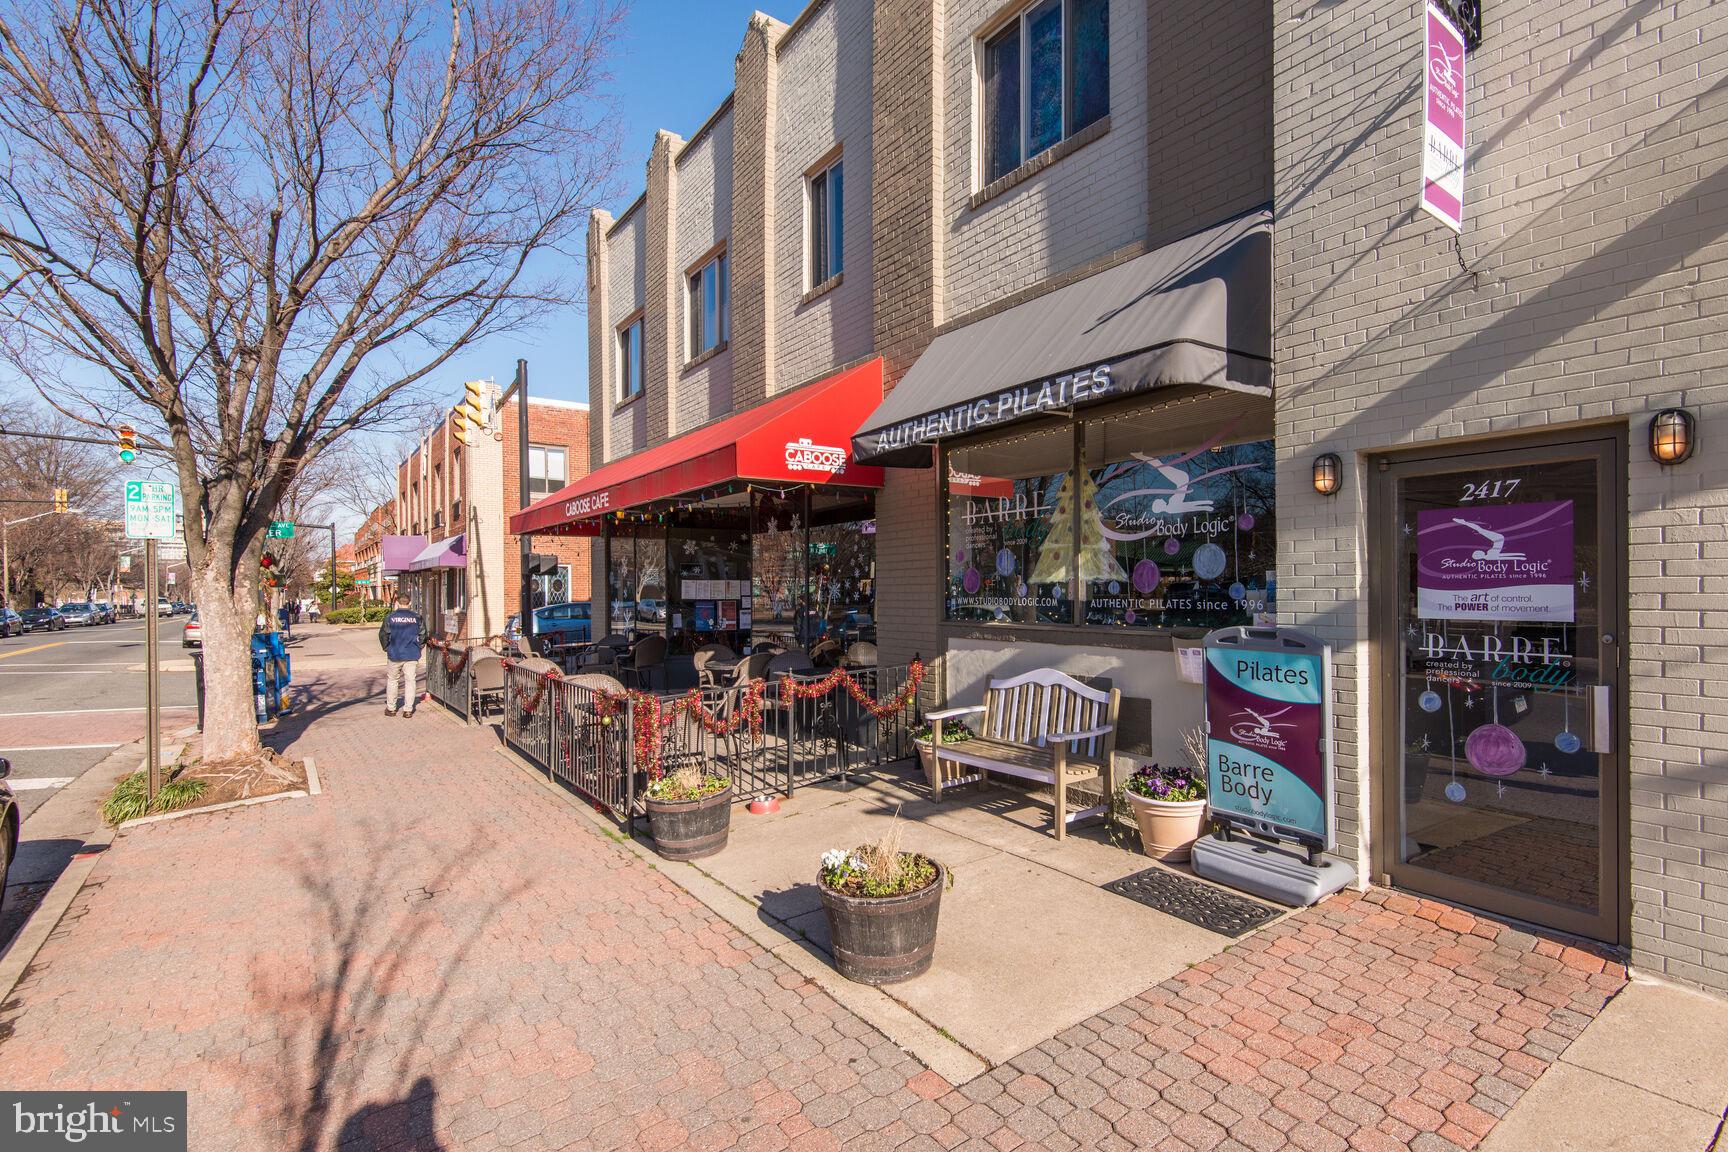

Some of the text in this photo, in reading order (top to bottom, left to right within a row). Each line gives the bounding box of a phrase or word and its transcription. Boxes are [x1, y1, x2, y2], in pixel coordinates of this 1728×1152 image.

[876, 364, 1112, 453] AUTHENTIC PILATES
[785, 448, 846, 466] CABOOSE
[128, 484, 140, 499] 2
[142, 493, 172, 502] PARKING
[1459, 478, 1521, 502] 2417
[565, 492, 610, 516] CABOOSE CAFE
[1116, 512, 1156, 528] Studio
[1156, 518, 1188, 538] Body
[1441, 558, 1476, 568] Studio
[1478, 560, 1508, 574] Body
[956, 596, 1058, 607] WWW.STUDIOBODYLOGIC.COM
[1090, 598, 1264, 610] AUTHENTIC PILATES since 1996
[1470, 592, 1489, 602] art
[1491, 594, 1499, 602] of
[1438, 603, 1452, 611] The
[1454, 602, 1488, 612] POWER
[1490, 604, 1500, 612] of
[1426, 632, 1560, 666] BARRE
[1236, 660, 1310, 686] Pilates
[1426, 660, 1472, 670] created by
[1426, 668, 1480, 678] professional
[1426, 675, 1460, 684] dancers
[1218, 754, 1274, 782] Barre
[1221, 775, 1274, 805] Body
[1234, 804, 1298, 825] studiobodylogic.com
